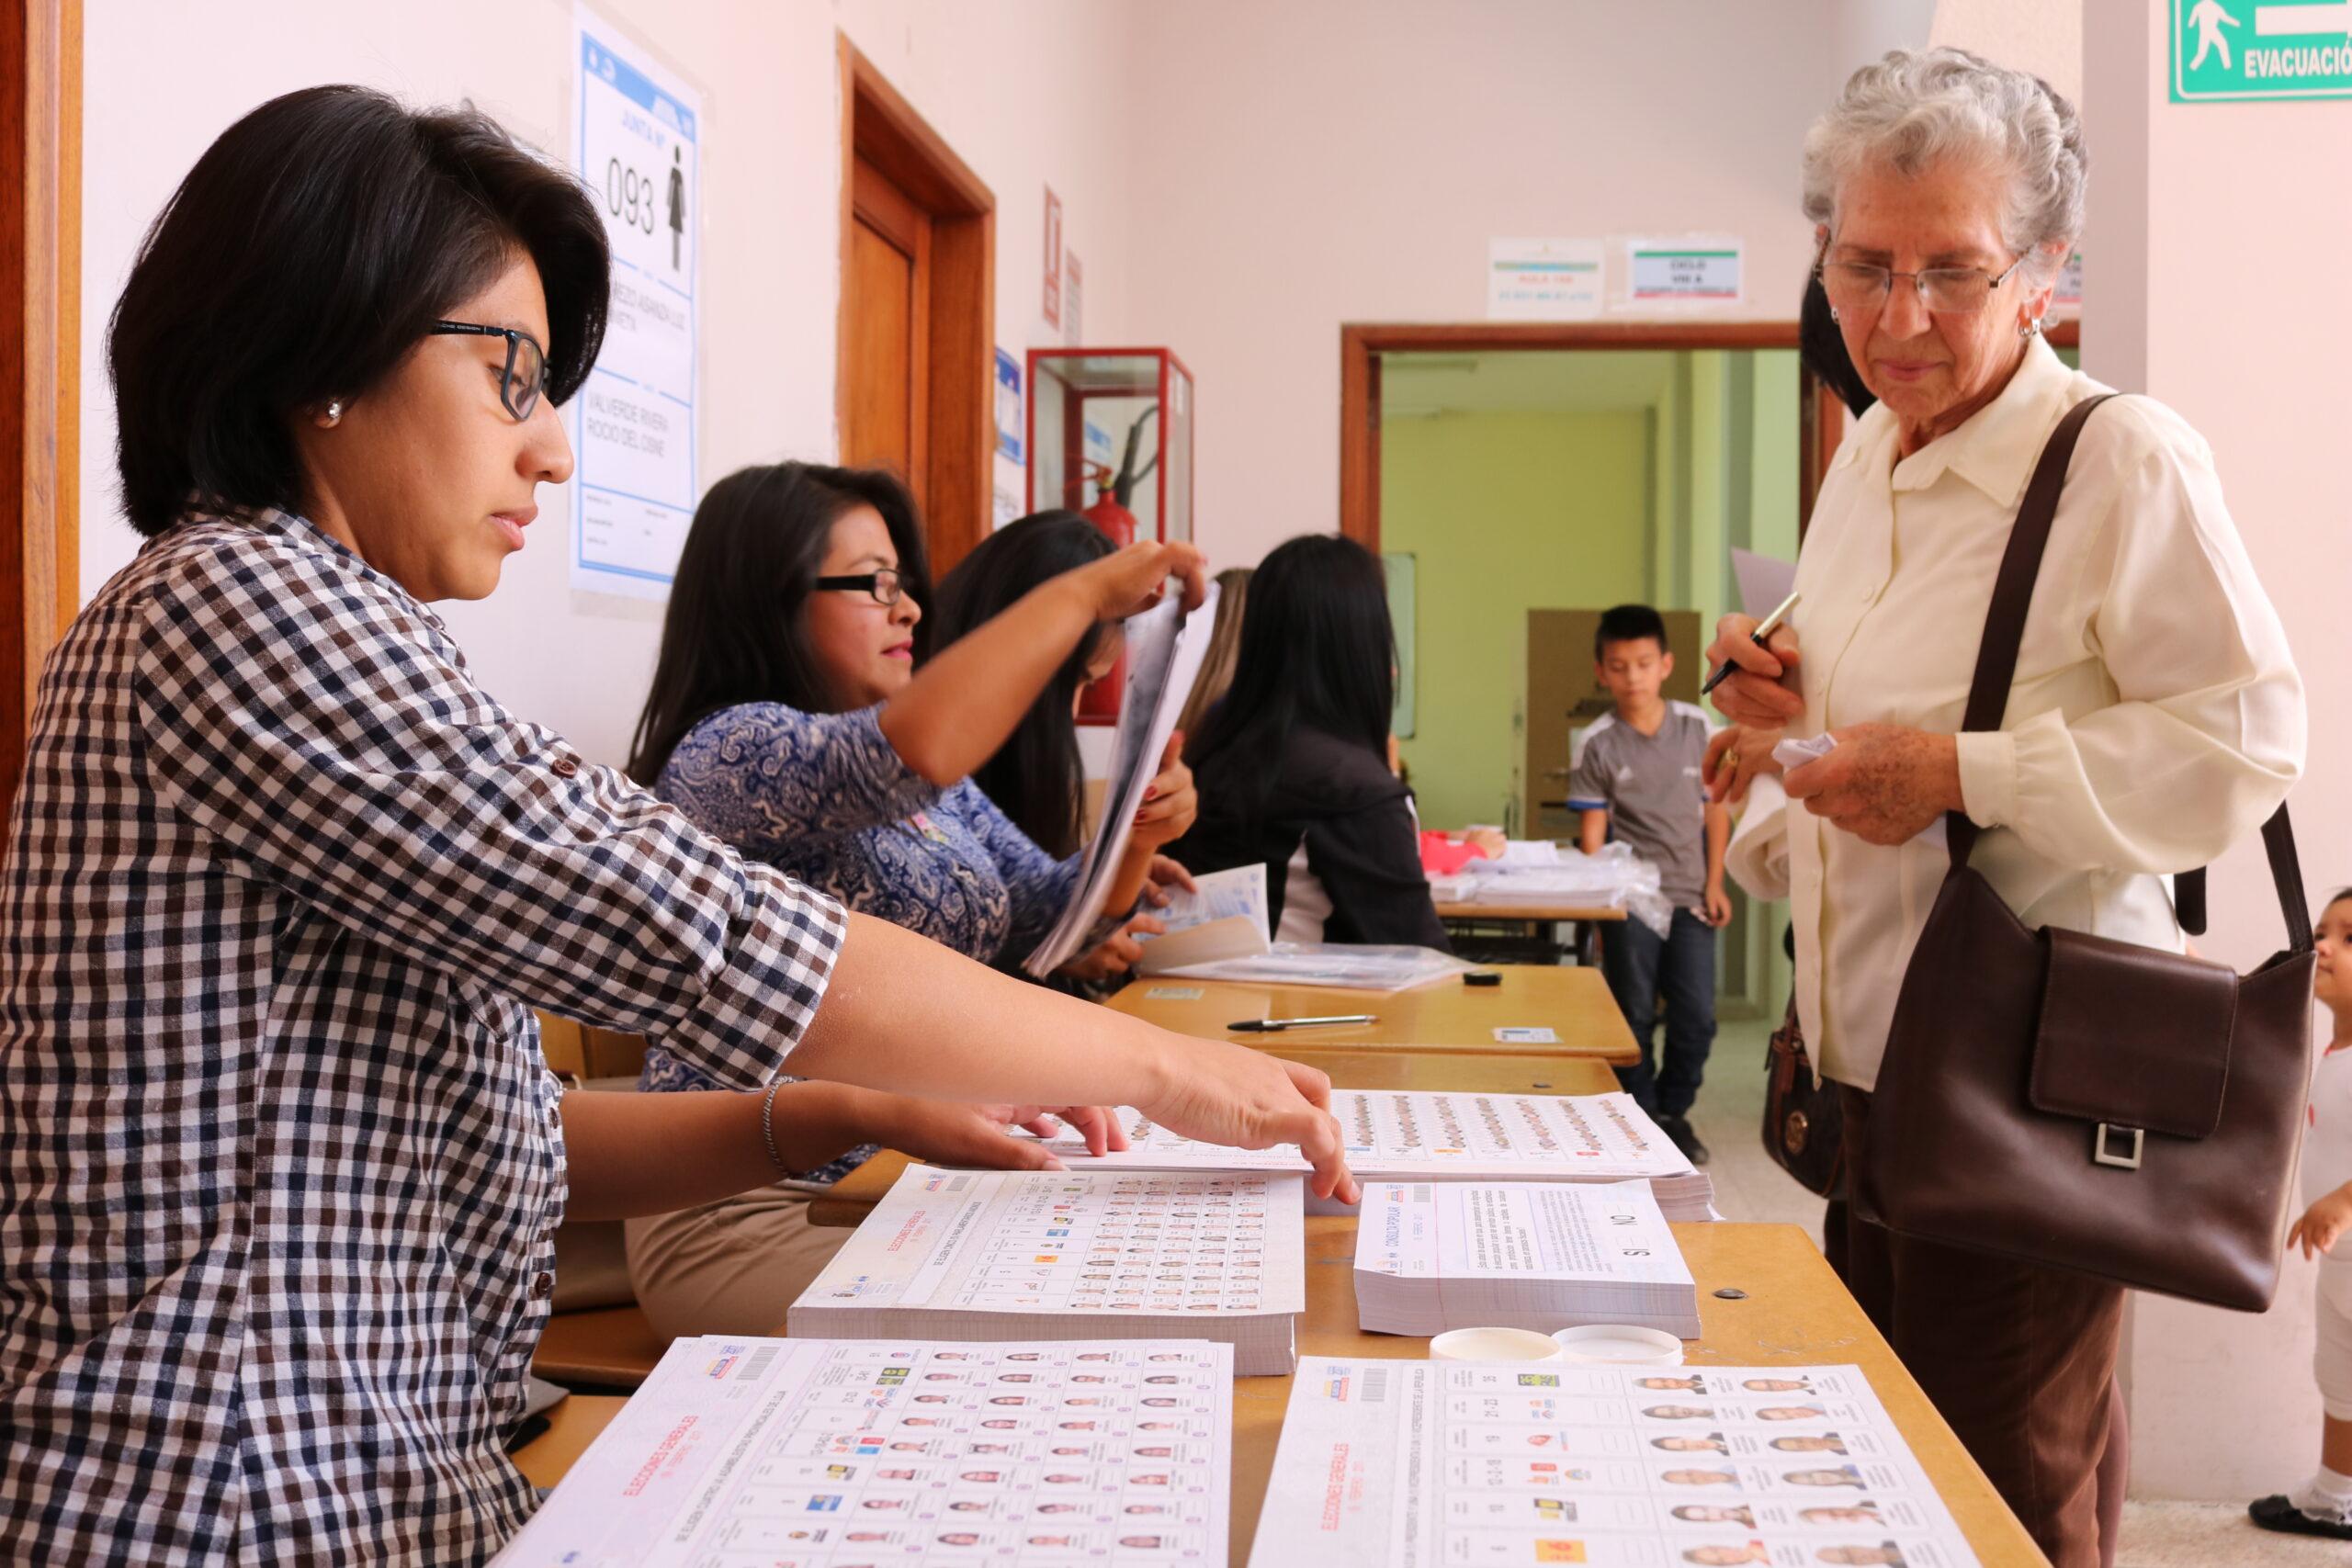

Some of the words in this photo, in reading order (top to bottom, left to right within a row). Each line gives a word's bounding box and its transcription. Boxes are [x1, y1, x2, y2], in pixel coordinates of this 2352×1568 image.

[606, 157, 654, 235] 093
[1385, 1205, 1400, 1224] POPULAR
[1608, 1214, 1638, 1225] NO
[885, 1229, 913, 1251] ELECCIONES
[1384, 1224, 1400, 1247] CONSULTA
[1621, 1247, 1651, 1256] SI
[619, 1450, 672, 1496] ELECCIONES
[655, 1415, 700, 1450] GENERALES
[1327, 1442, 1351, 1483] GENERALES
[1318, 1483, 1346, 1531] ELECCIONES
